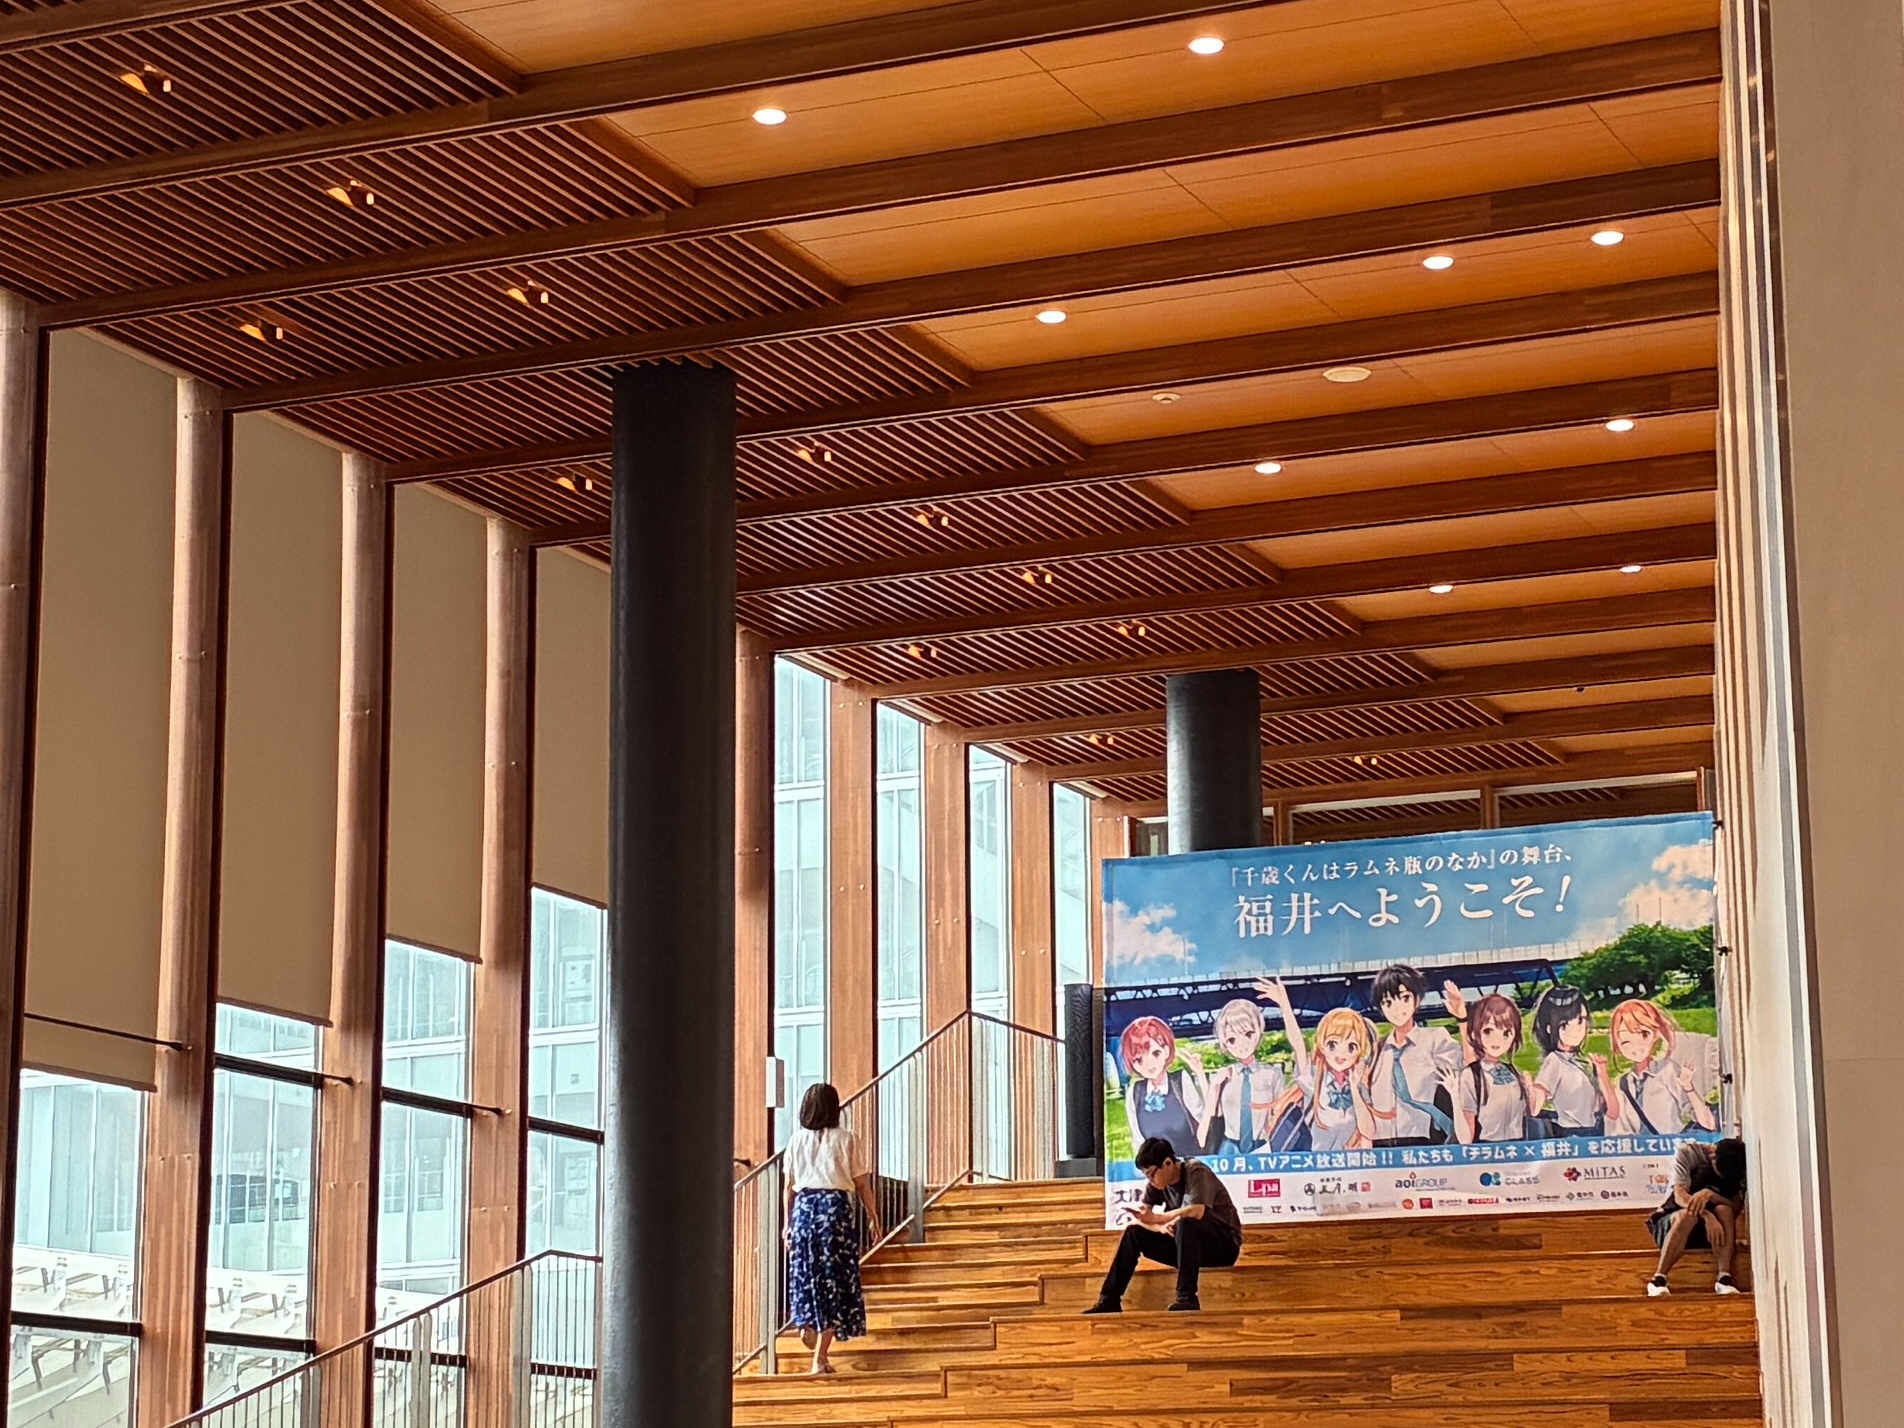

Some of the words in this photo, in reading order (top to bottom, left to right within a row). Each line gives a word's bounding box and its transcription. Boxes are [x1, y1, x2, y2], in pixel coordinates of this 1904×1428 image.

[1233, 874, 1572, 939] 福井へようこそ！
